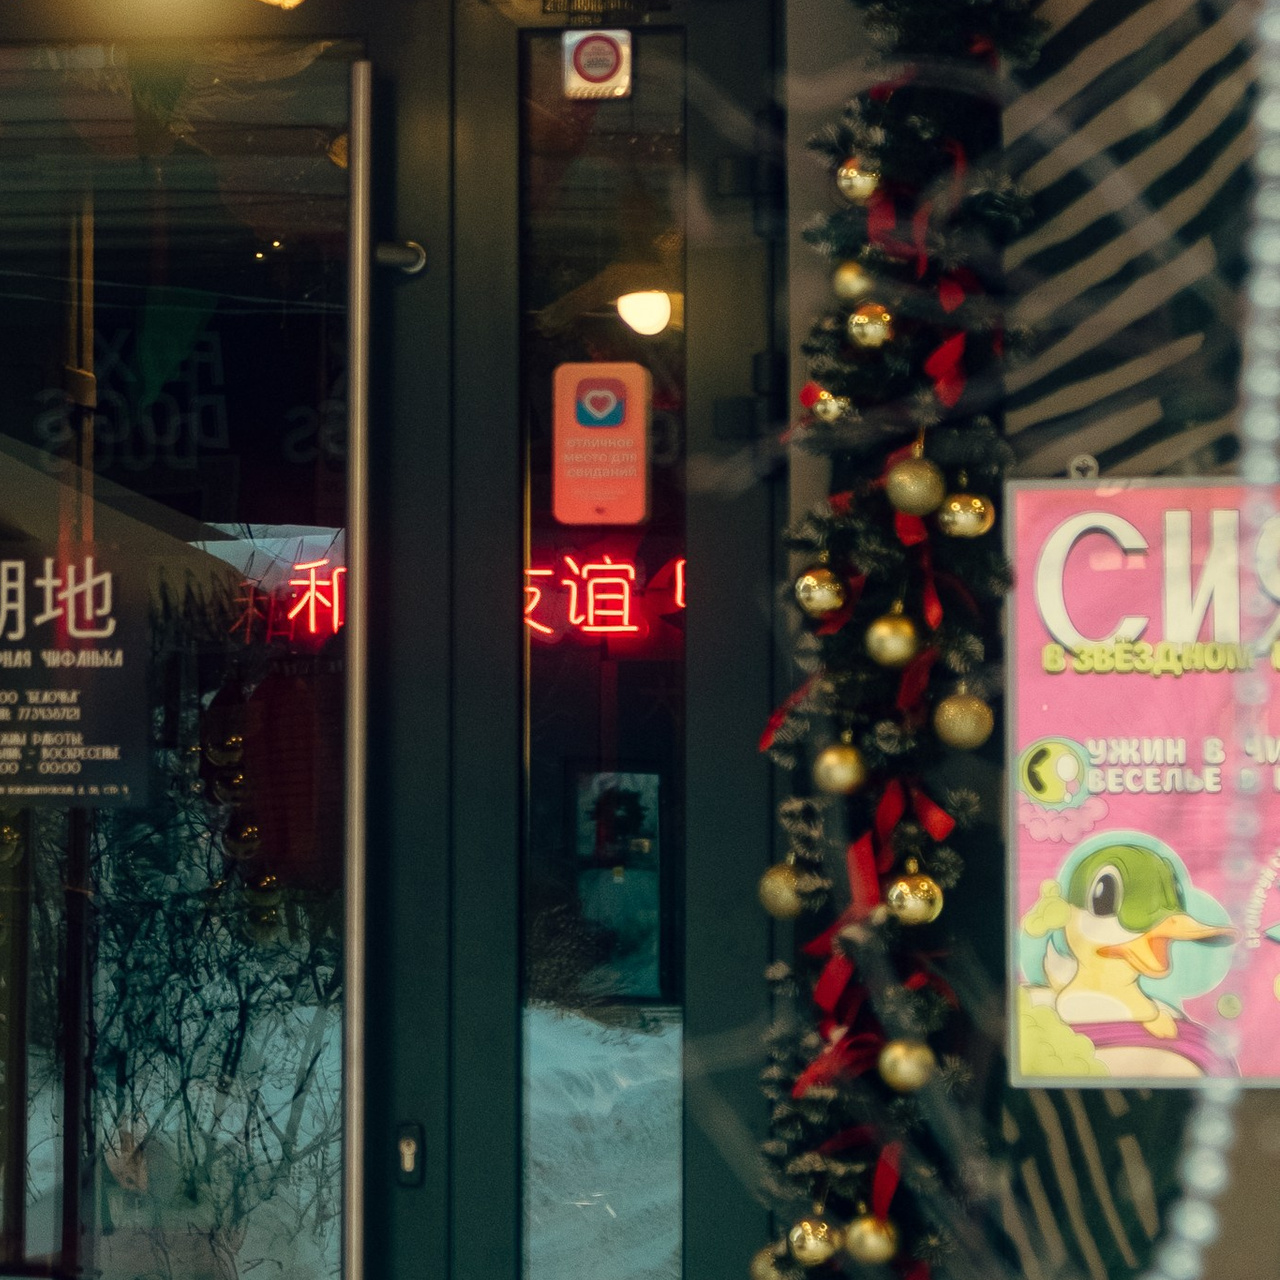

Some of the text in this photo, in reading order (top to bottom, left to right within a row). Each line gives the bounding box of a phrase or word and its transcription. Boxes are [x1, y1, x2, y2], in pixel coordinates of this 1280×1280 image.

[1034, 509, 1280, 658] СИ
[41, 648, 123, 668] ЧИФАНЬКА
[1042, 642, 1066, 673] В
[1086, 737, 1186, 765] УЖИН
[1204, 736, 1226, 765] В
[1088, 767, 1222, 794] ВЕСЕЛЬЕ
